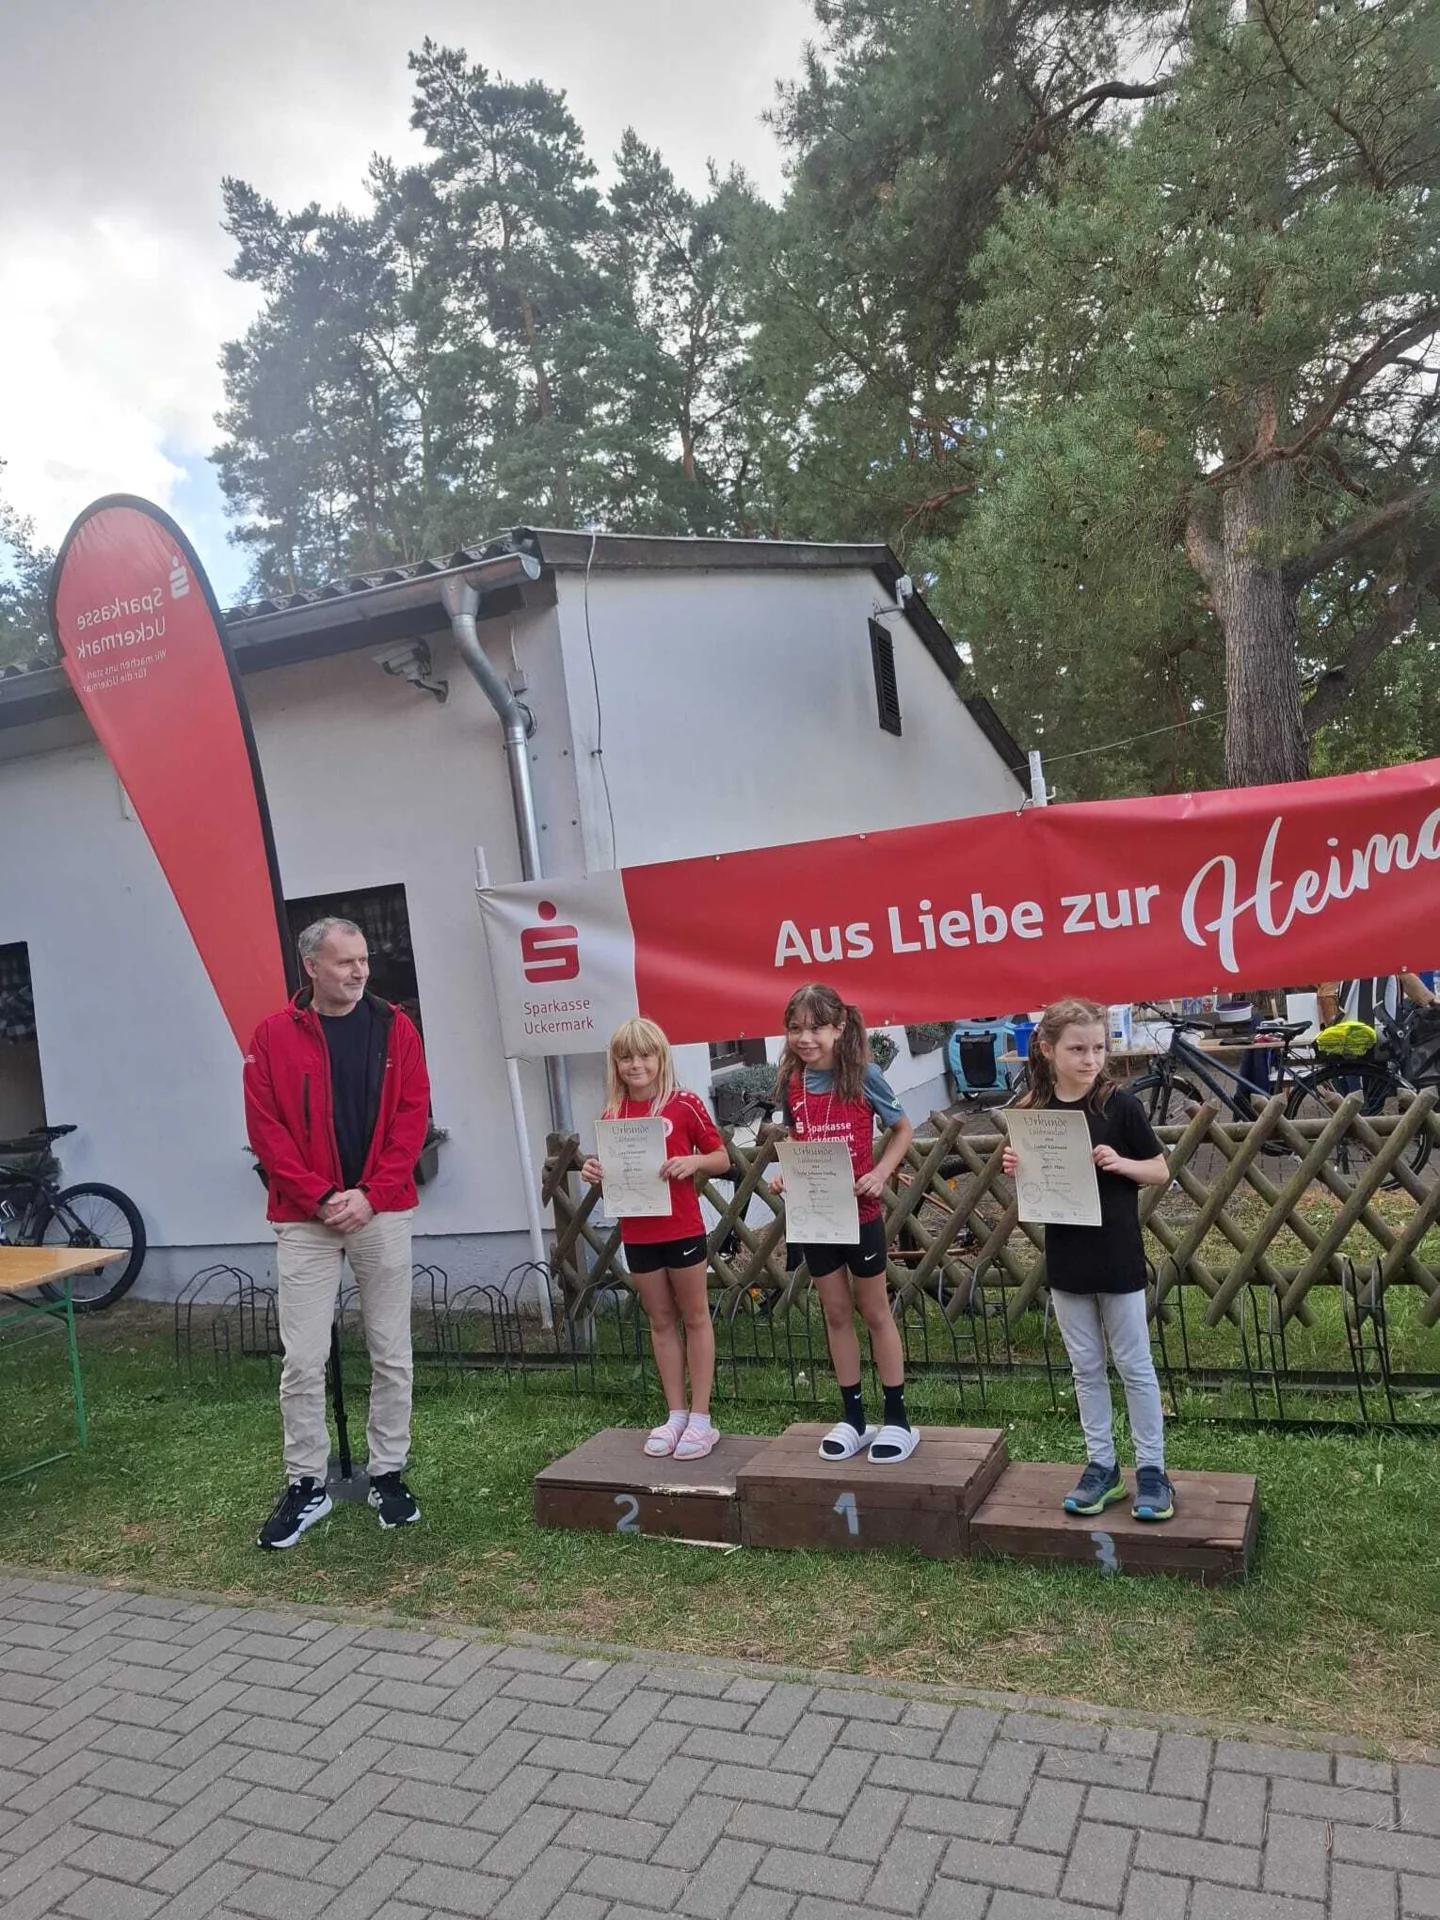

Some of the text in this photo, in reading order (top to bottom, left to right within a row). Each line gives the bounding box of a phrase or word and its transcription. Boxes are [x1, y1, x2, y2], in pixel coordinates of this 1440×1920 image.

[774, 919, 874, 967] Aus
[888, 892, 1043, 954] Liebe
[1060, 884, 1160, 934] zur
[523, 999, 590, 1017] Sparkasse
[524, 1016, 594, 1035] Uckermark
[807, 1122, 851, 1134] Sparkasse
[1023, 1113, 1067, 1127] Urkunde
[614, 1494, 640, 1534] 2
[833, 1493, 858, 1535] 1
[1090, 1532, 1118, 1573] 3
